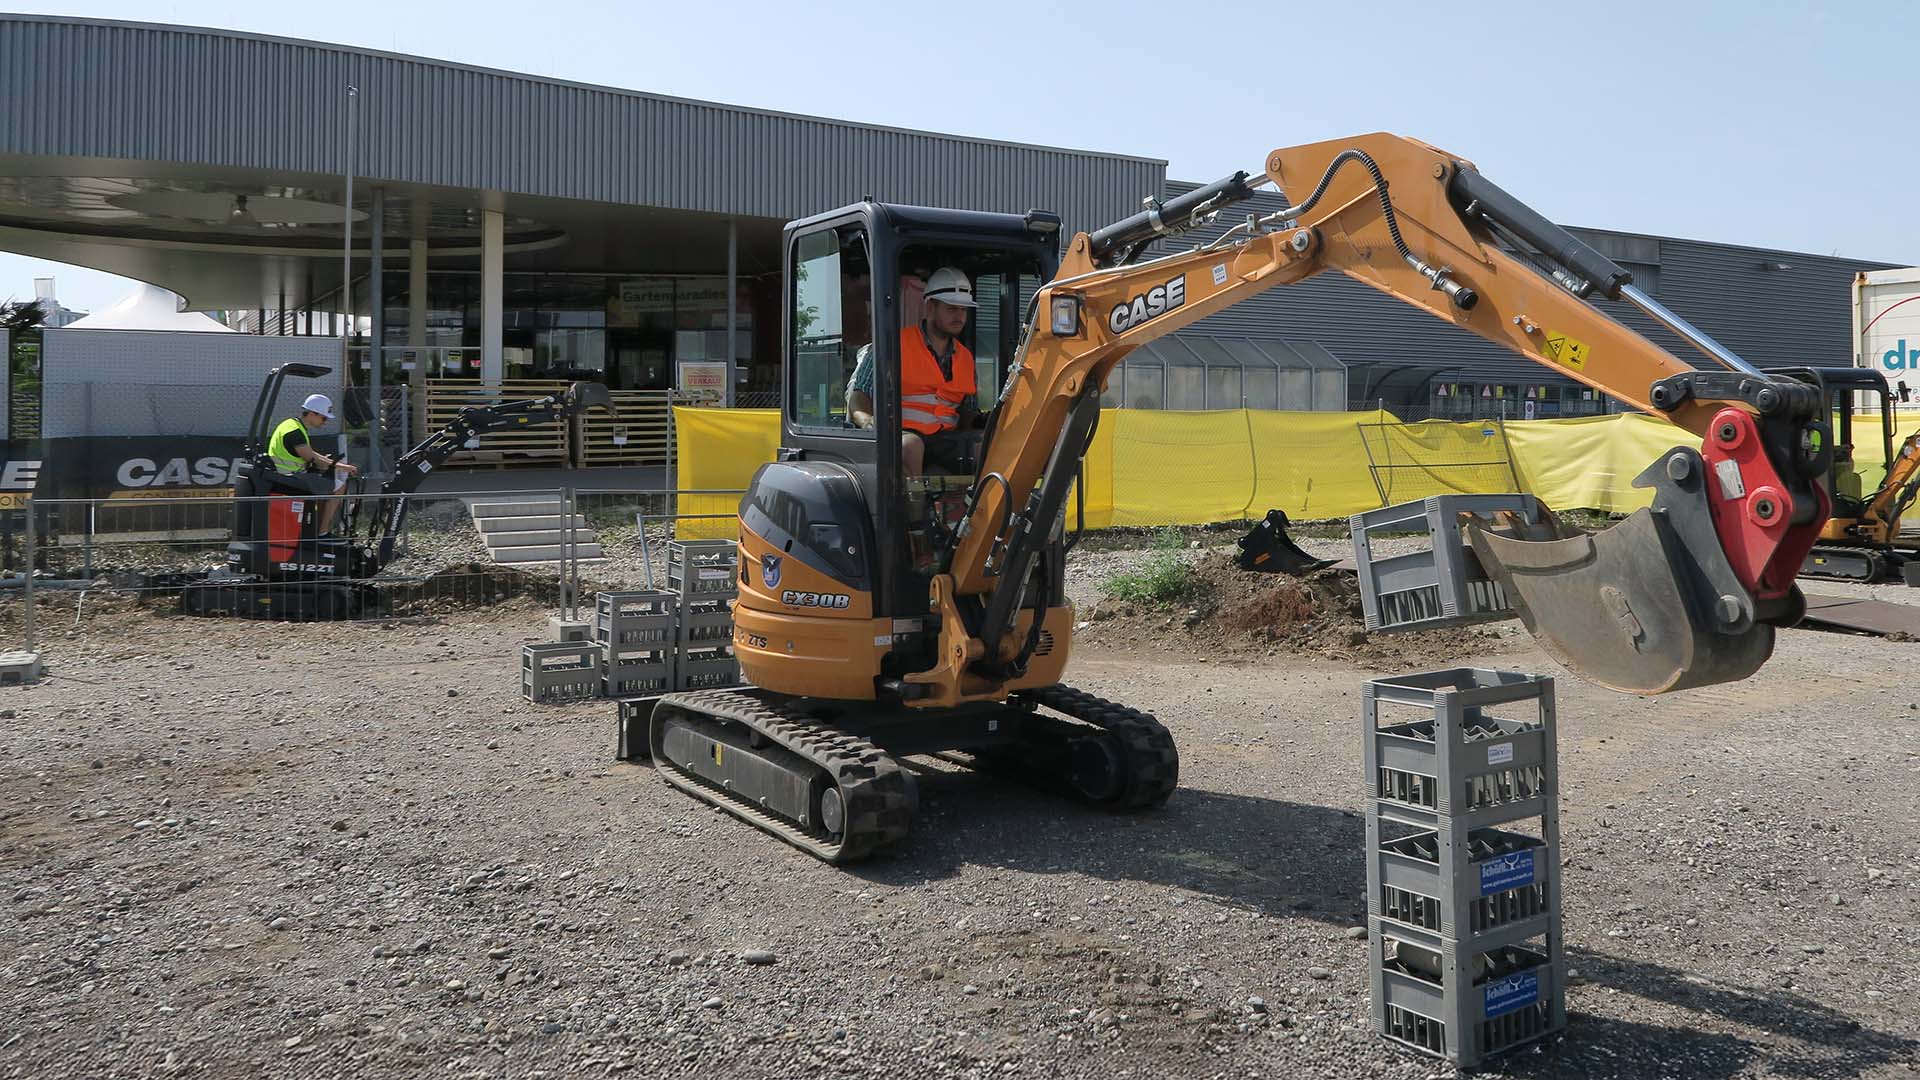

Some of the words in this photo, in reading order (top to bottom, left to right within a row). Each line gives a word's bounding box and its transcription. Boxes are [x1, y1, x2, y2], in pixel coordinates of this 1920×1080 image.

[1109, 274, 1186, 334] CASE
[279, 562, 335, 573] ES12ZT
[782, 590, 850, 609] CX30B
[748, 633, 768, 649] ZTS
